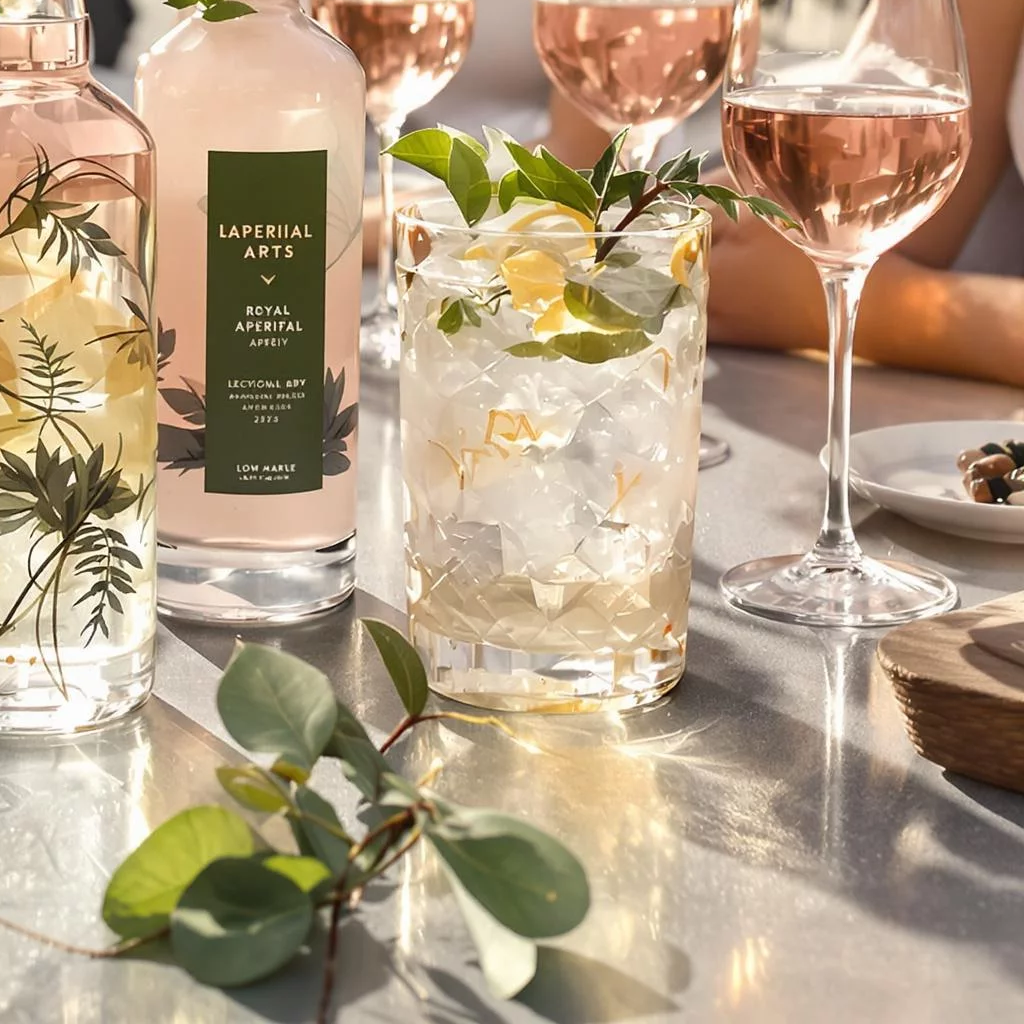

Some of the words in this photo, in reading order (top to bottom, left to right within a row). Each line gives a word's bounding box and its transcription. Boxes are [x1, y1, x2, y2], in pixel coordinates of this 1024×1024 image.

[219, 223, 313, 239] LAPERIIAL
[243, 244, 294, 259] ARTS
[245, 304, 291, 317] ROYAL
